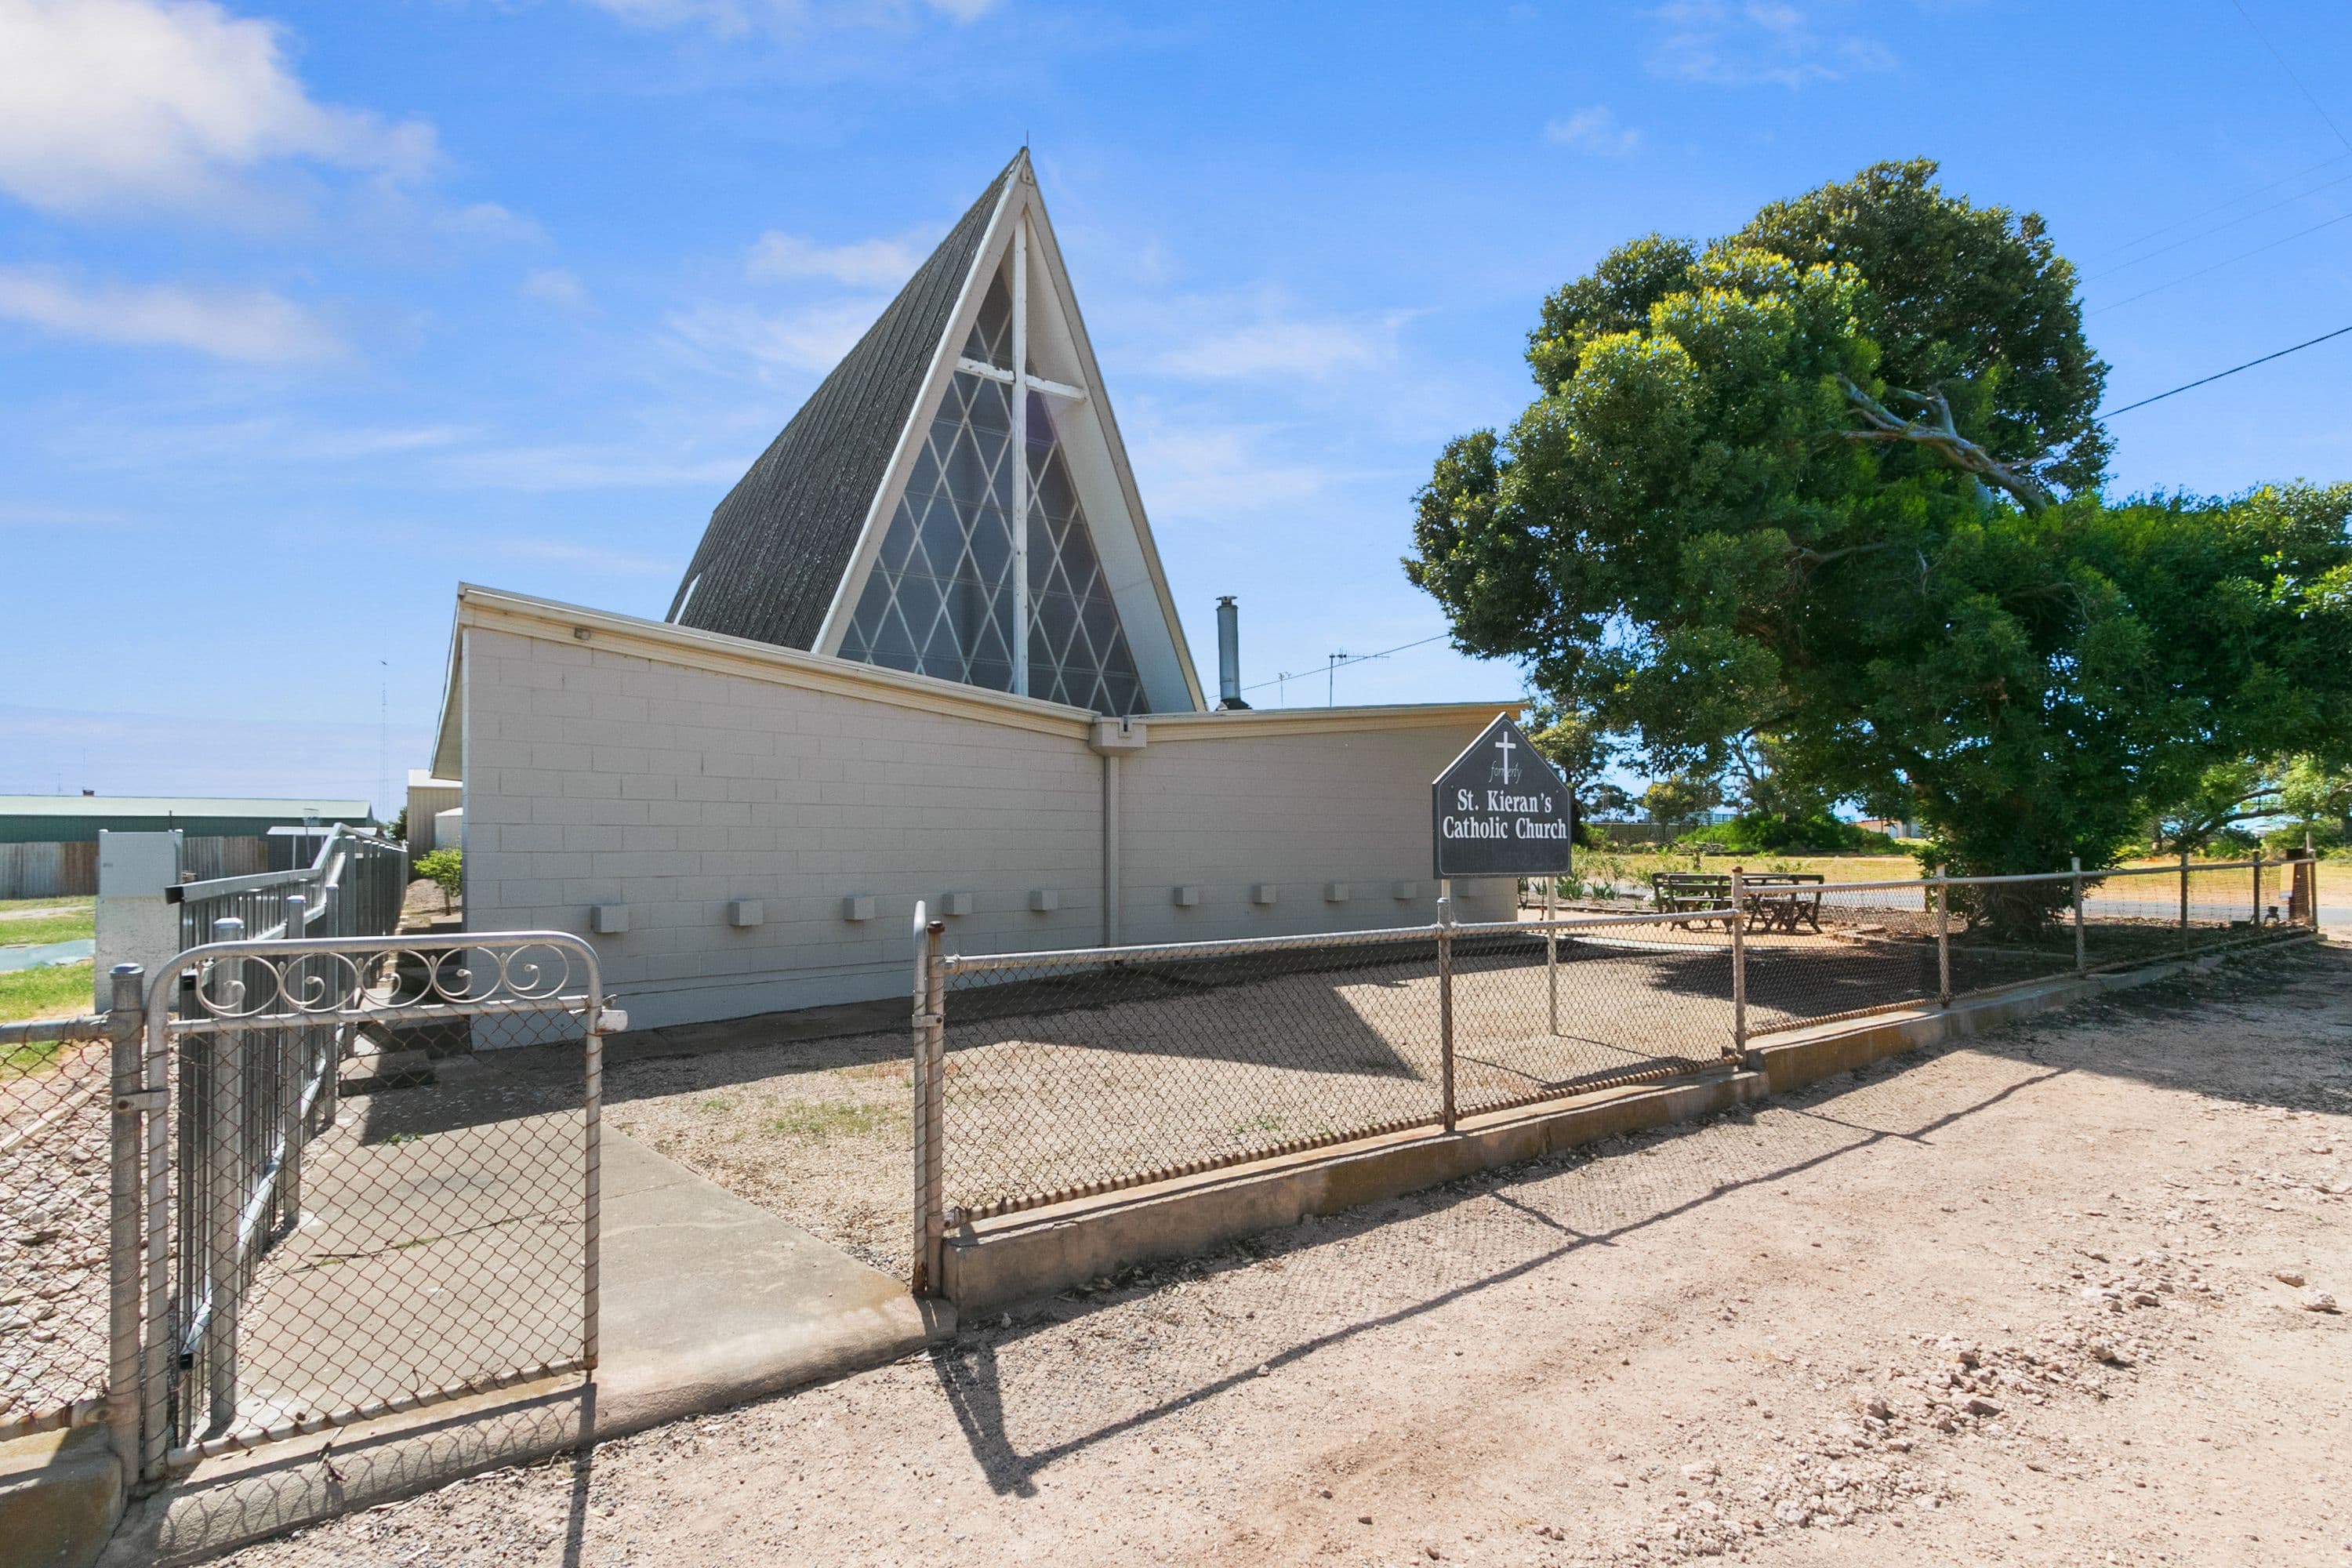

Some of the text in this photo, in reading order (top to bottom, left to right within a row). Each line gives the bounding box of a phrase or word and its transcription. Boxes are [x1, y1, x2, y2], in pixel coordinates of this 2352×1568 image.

[1457, 789, 1552, 812] St. Kieran's
[1443, 815, 1567, 839] Catholic Church
